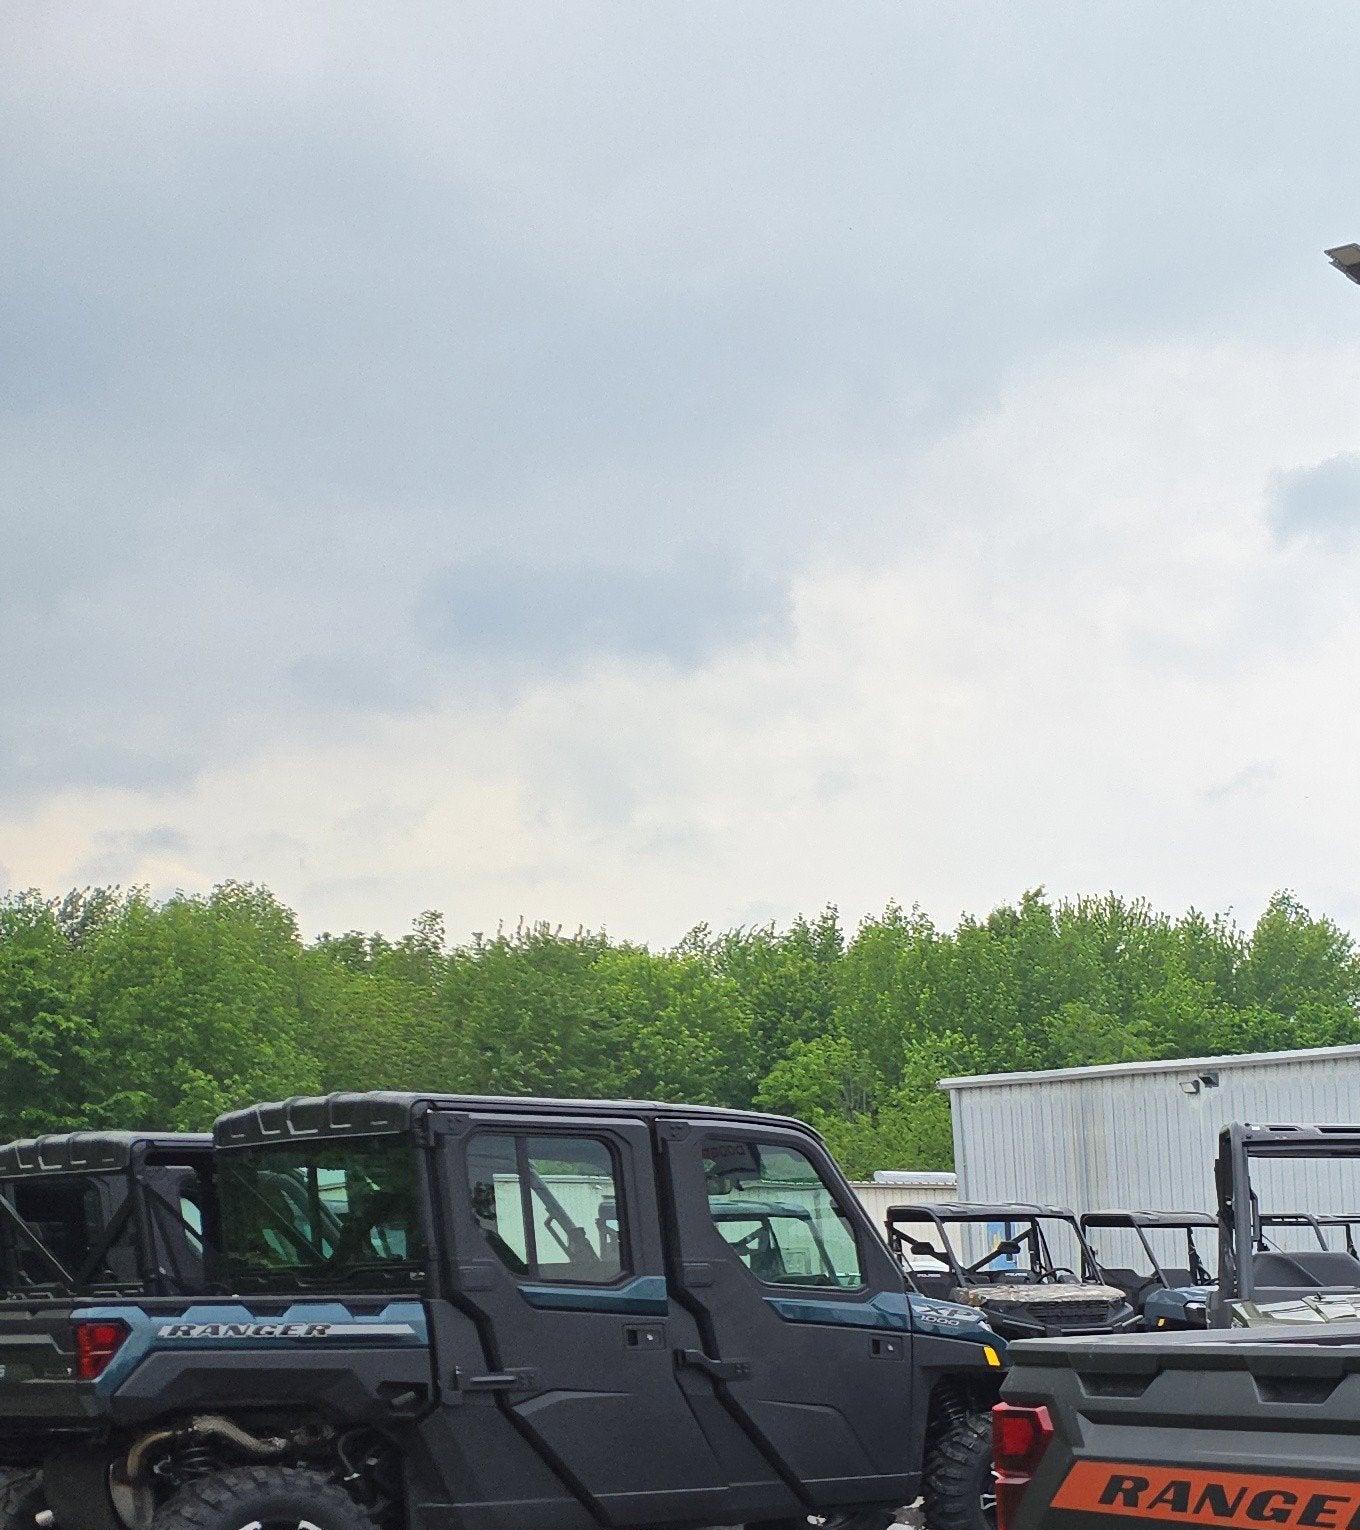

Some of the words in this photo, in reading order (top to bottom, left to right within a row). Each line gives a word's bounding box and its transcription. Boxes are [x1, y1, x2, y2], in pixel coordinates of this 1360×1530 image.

[919, 1304, 974, 1318] XP
[921, 1315, 960, 1327] 1000
[165, 1323, 333, 1338] RANGER
